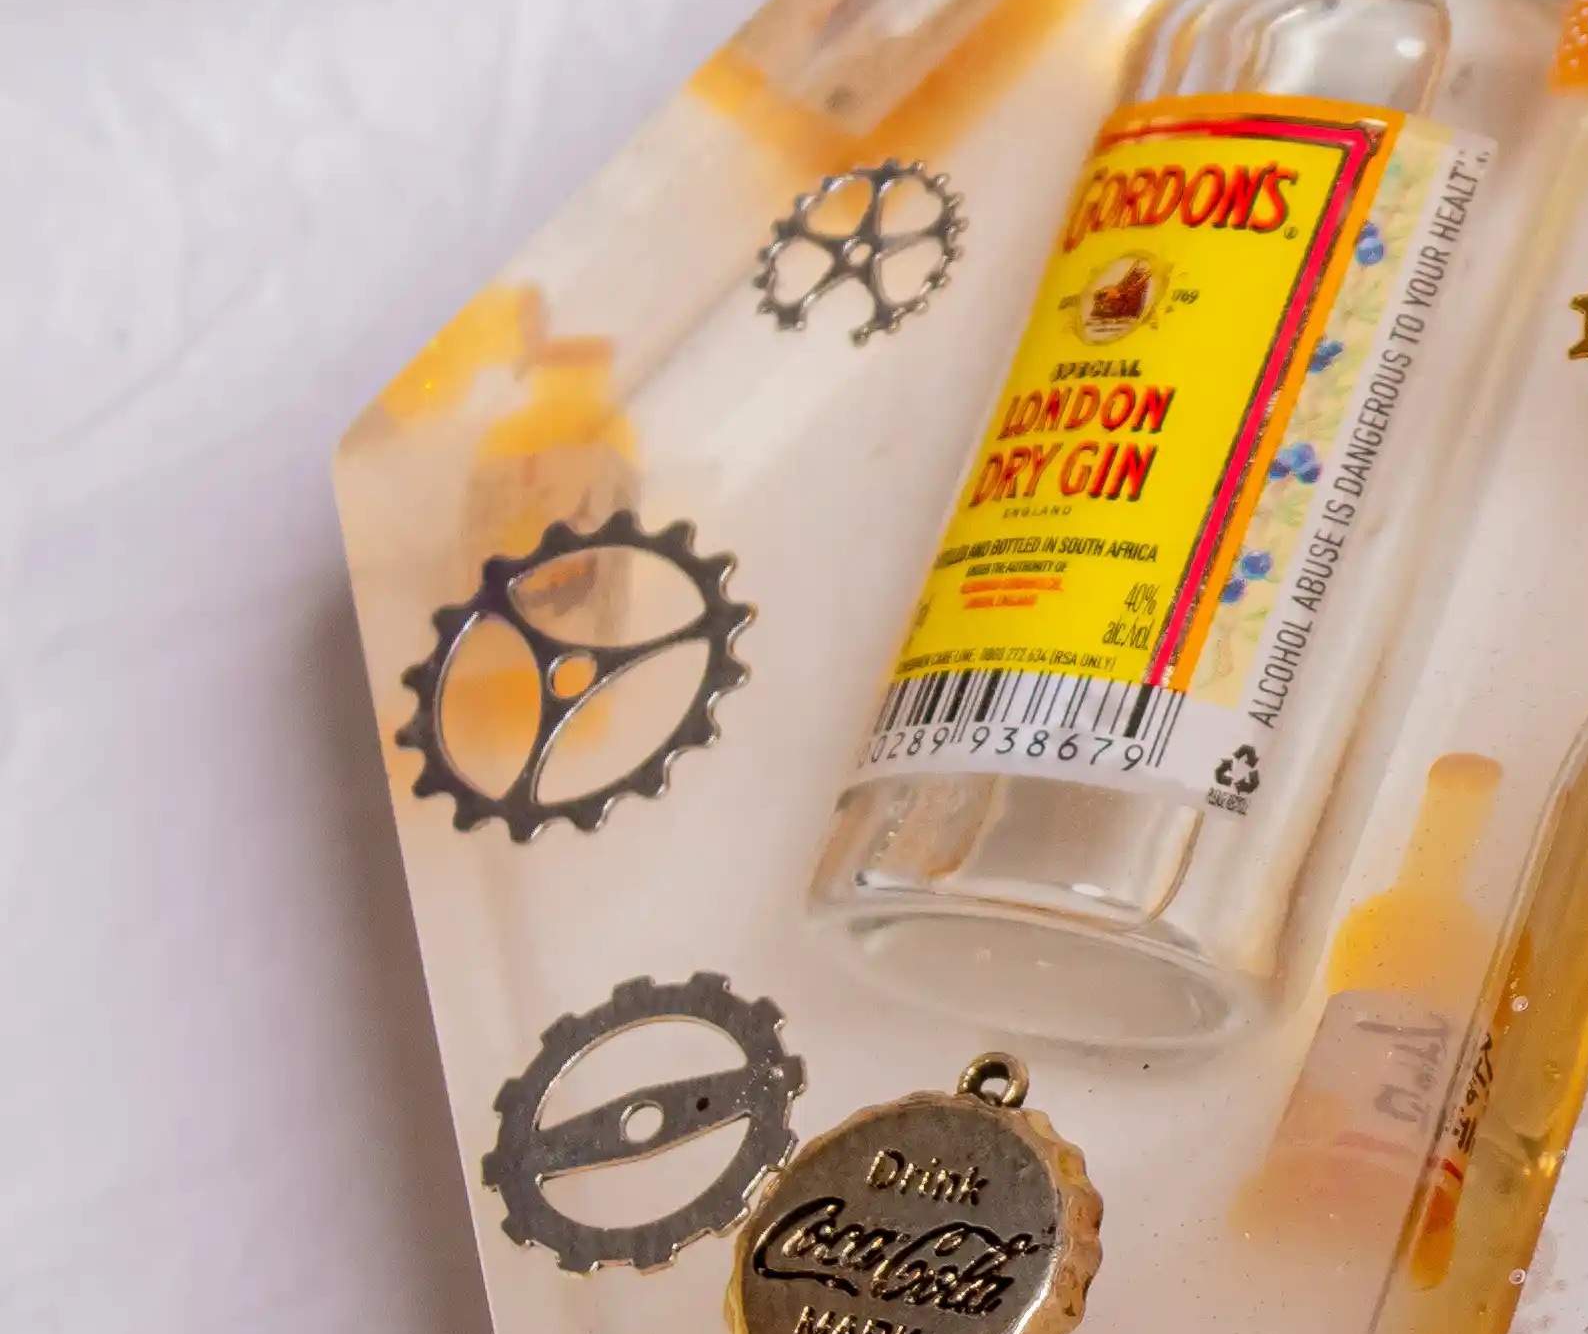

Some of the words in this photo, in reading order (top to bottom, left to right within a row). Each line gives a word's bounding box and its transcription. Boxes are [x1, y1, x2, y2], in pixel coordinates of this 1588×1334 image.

[1403, 244, 1451, 308] YOUR
[1389, 313, 1426, 345] TO
[997, 381, 1177, 440] LONDON
[1334, 348, 1413, 498] DANGEROUS
[968, 442, 1064, 509] DRY
[1059, 439, 1158, 502] GIN
[1003, 504, 1073, 519] ENGLAND
[1321, 499, 1355, 526] IS
[989, 536, 1042, 556] BOTTLED
[1042, 536, 1060, 554] IN
[1058, 536, 1105, 557] SOUTH
[1105, 539, 1160, 562] AFRICA
[1291, 527, 1345, 613] ABUSE
[1123, 581, 1162, 616] 40%
[1248, 619, 1314, 729] ALCOHOL
[969, 724, 1145, 771] 938679
[864, 1148, 989, 1205] Drink
